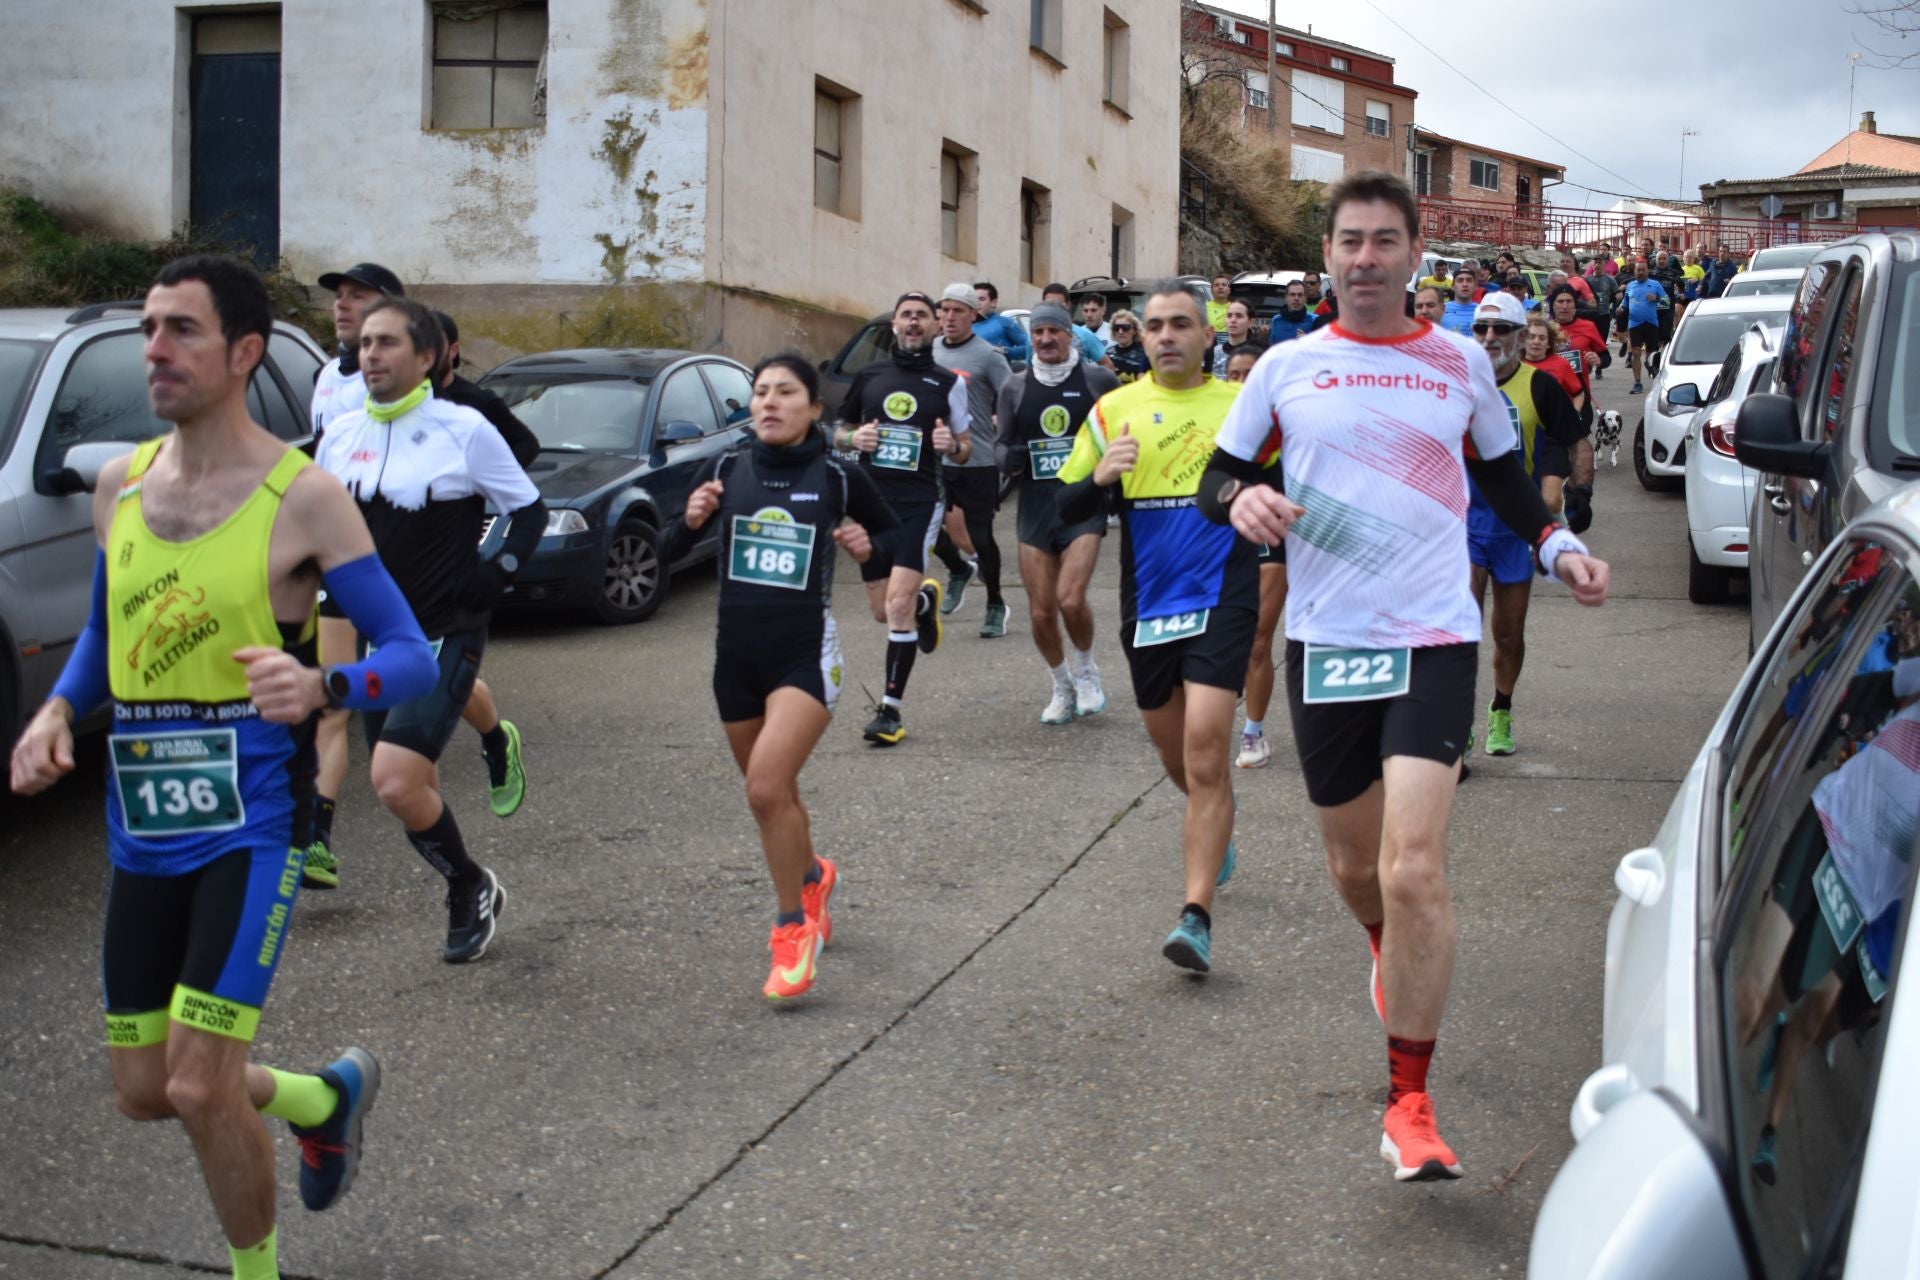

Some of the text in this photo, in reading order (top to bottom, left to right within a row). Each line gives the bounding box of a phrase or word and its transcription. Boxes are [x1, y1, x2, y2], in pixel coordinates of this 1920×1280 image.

[1345, 373, 1448, 400] smartlog
[1157, 419, 1196, 451] RINCON
[877, 445, 911, 462] 232
[743, 546, 797, 575] 186
[123, 568, 180, 621] RINCON
[1150, 612, 1197, 636] 142
[143, 618, 220, 687] ATLETISMO
[1322, 653, 1394, 687] 222
[134, 704, 152, 719] DE
[155, 704, 192, 718] SOTO
[137, 777, 219, 816] 136
[181, 1007, 197, 1021] DE
[184, 995, 240, 1020] RINCÓN
